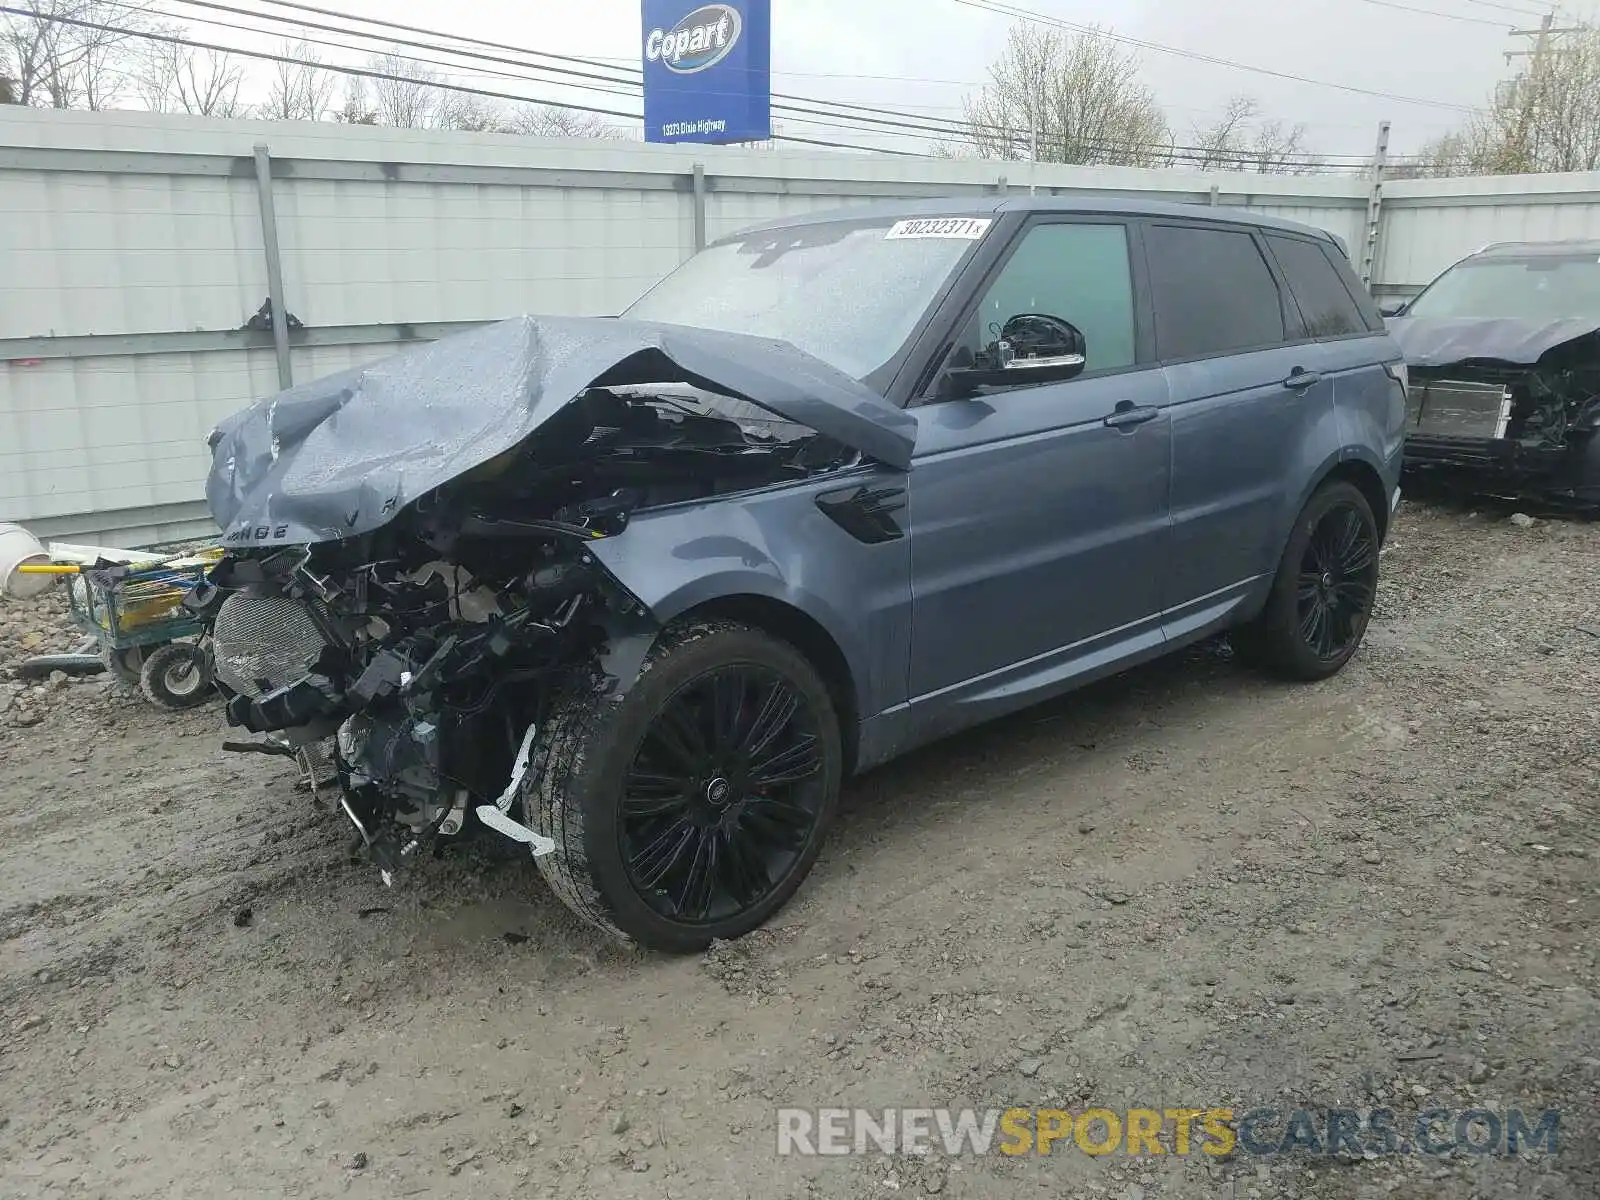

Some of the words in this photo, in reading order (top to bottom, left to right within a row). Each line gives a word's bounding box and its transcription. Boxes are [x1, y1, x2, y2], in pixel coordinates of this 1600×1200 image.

[646, 9, 729, 63] Copart
[680, 121, 697, 135] Dixie
[697, 119, 726, 135] Highway
